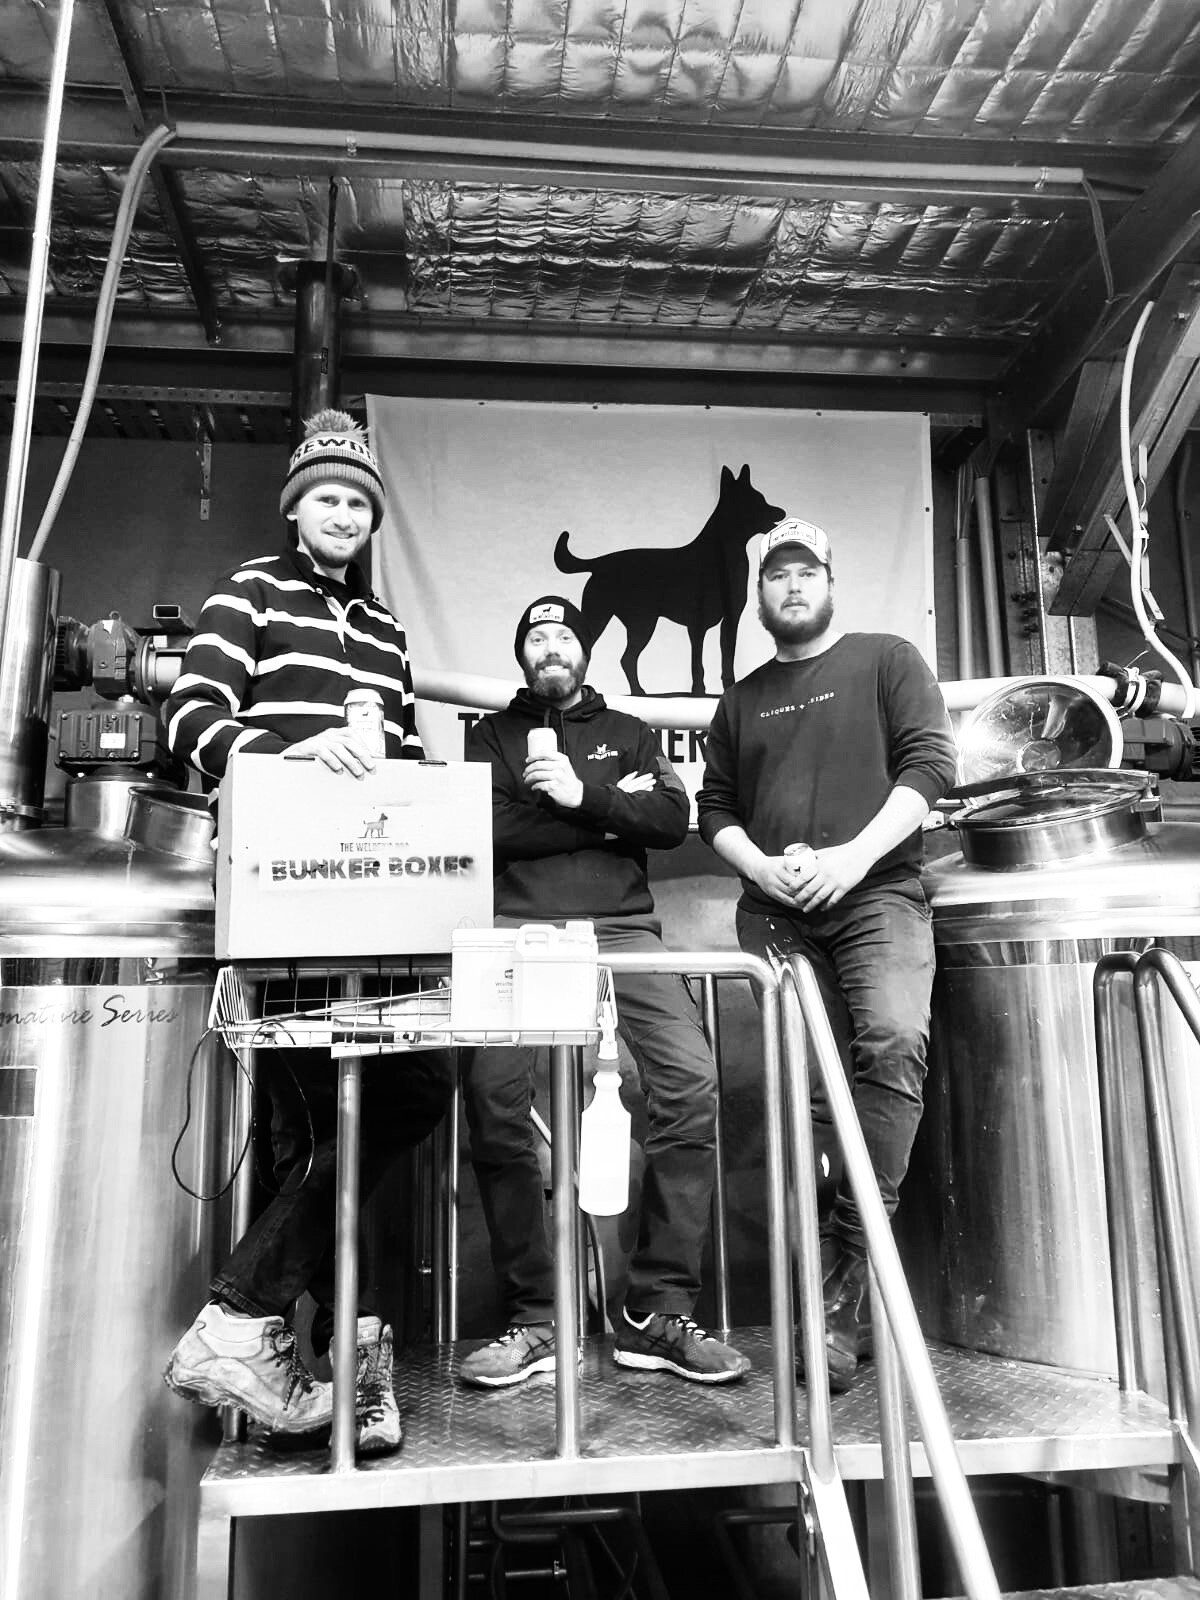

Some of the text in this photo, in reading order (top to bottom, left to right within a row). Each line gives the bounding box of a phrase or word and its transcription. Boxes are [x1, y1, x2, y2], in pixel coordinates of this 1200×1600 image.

[340, 842, 354, 853] THE
[271, 855, 475, 882] BUNKER BOXES
[100, 993, 179, 1028] Series
